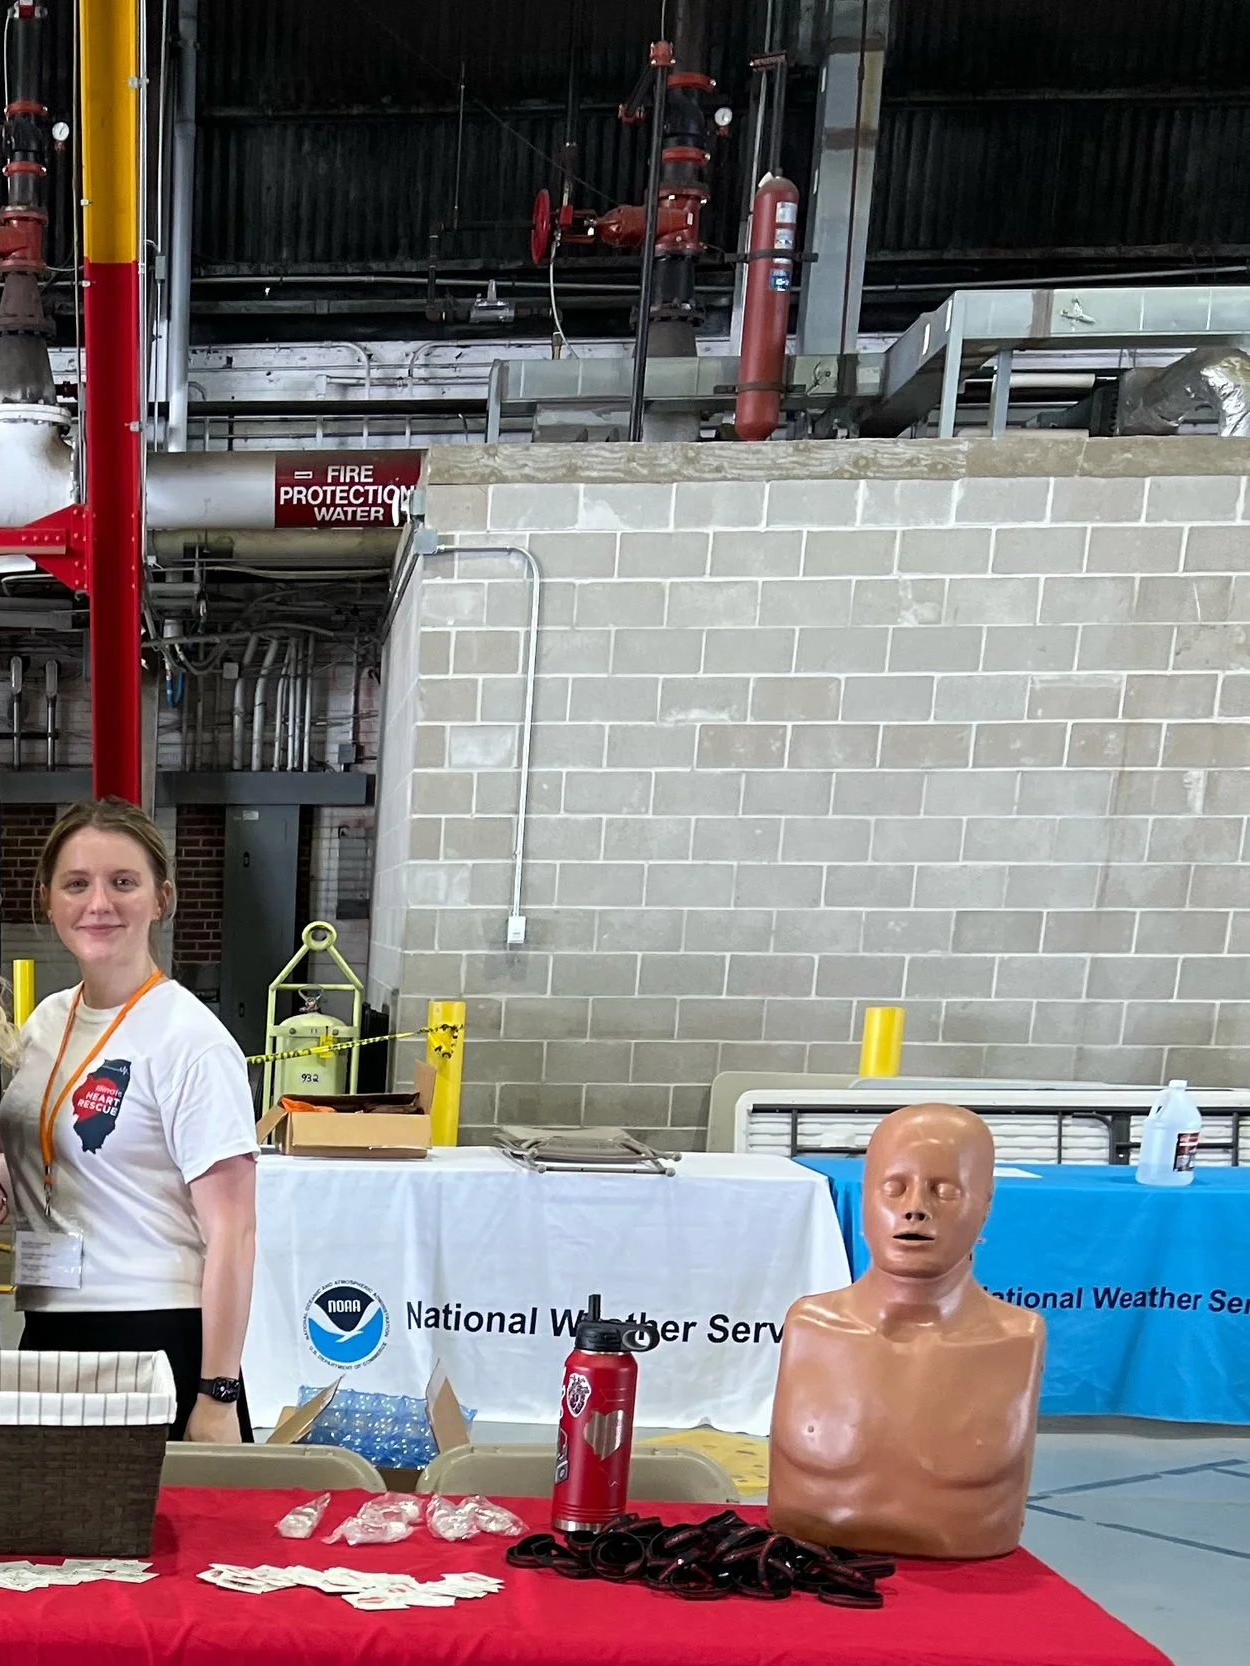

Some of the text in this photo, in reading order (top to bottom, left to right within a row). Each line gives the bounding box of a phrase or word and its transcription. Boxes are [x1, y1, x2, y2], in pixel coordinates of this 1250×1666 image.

[327, 465, 374, 483] FIRE
[294, 507, 375, 521] WATER
[301, 1074, 319, 1083] 932
[77, 1098, 118, 1116] RESCUE
[85, 1092, 120, 1107] HEART
[328, 1300, 361, 1312] NOAA
[1093, 1286, 1203, 1310] Weather
[405, 1300, 538, 1335] National
